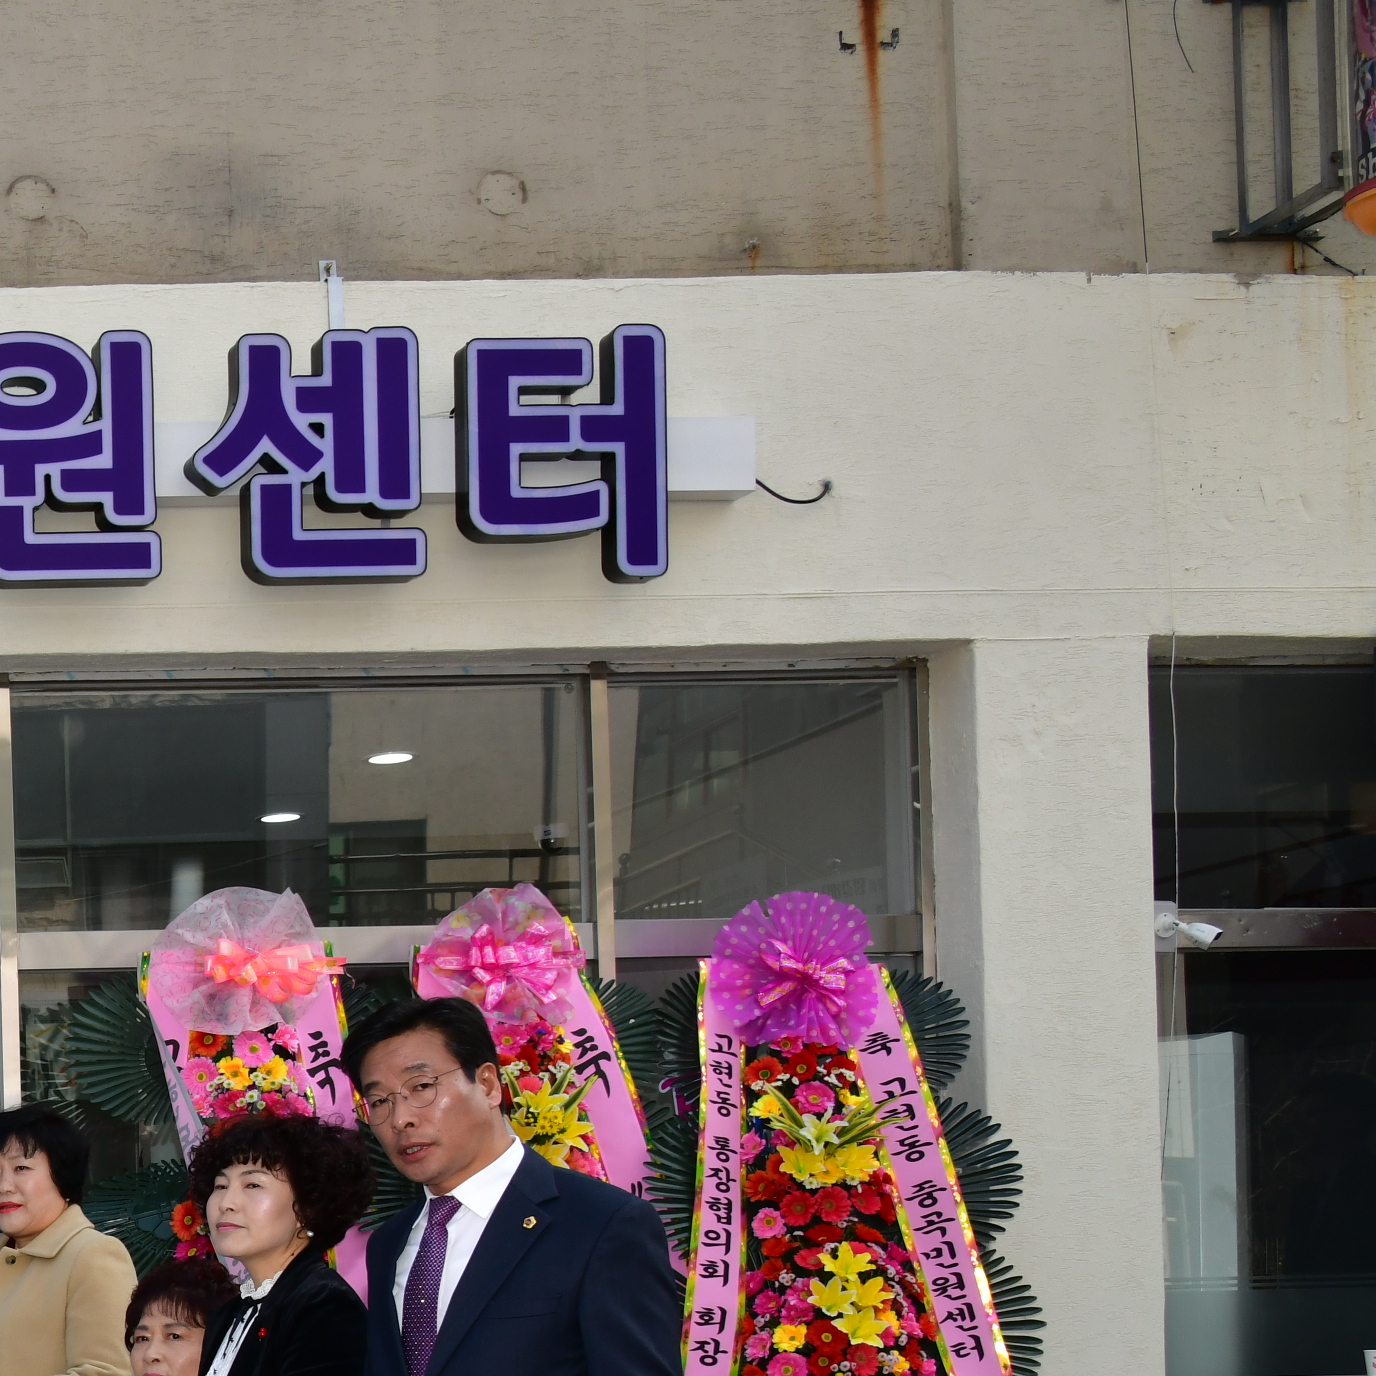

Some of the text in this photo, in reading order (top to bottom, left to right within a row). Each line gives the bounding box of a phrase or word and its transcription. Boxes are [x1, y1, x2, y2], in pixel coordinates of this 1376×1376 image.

[306, 1031, 344, 1106] 축
[572, 1027, 611, 1098] 축
[708, 1032, 739, 1118] 고현동
[858, 1031, 900, 1058] 축
[877, 1076, 934, 1163] 고현동
[698, 1135, 739, 1289] 통장협의회
[904, 1179, 986, 1363] 중곡민원센터
[689, 1306, 729, 1367] 회장
